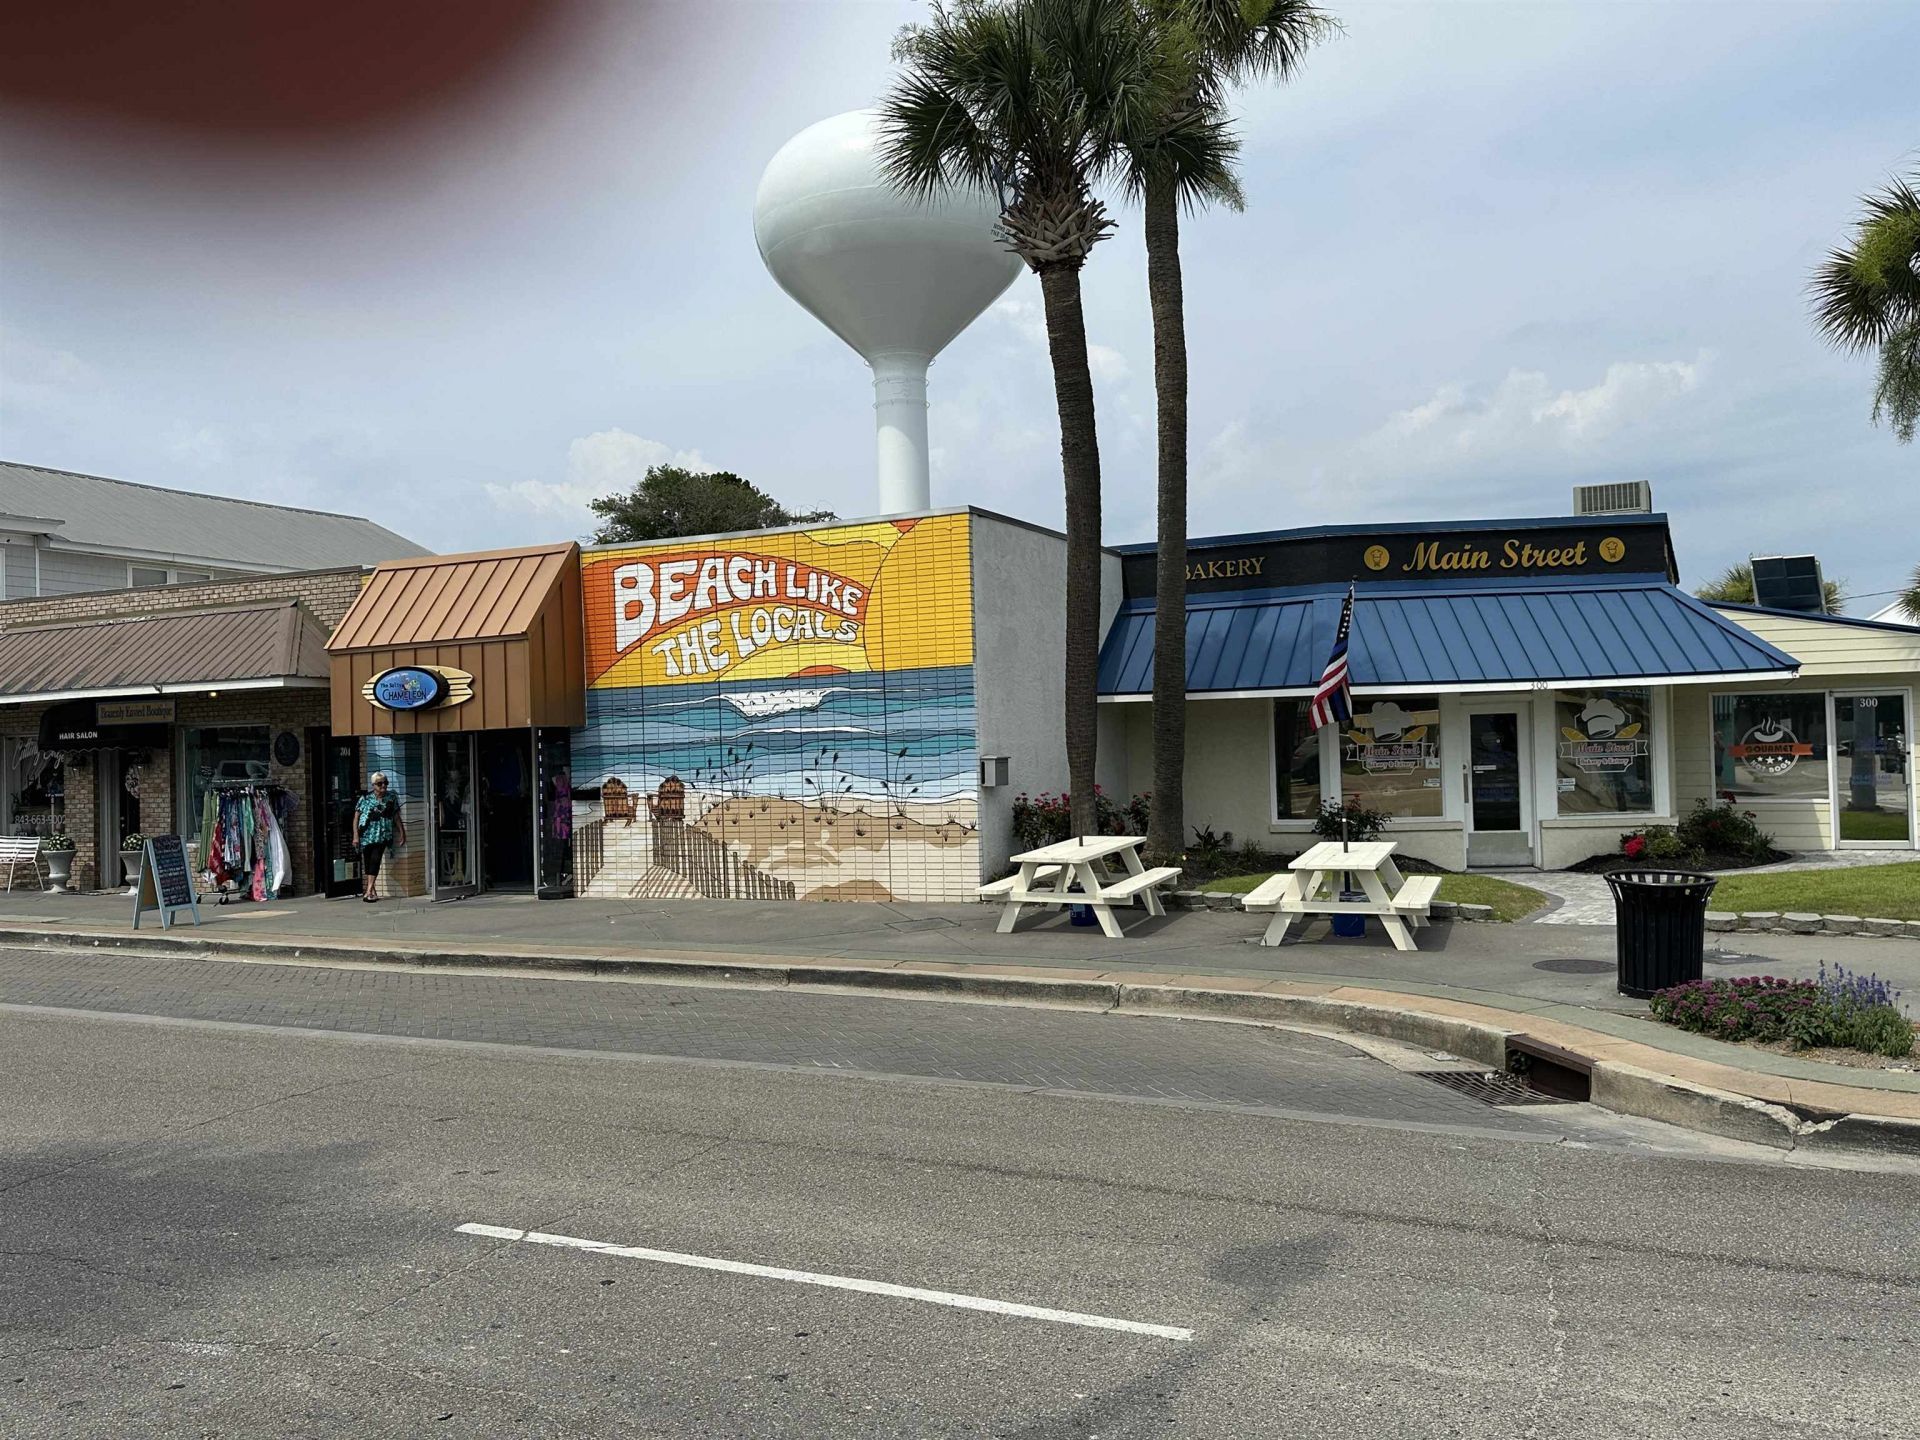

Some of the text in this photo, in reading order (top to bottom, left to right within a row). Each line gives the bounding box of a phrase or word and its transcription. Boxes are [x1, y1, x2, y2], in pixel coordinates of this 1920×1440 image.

[1403, 539, 1587, 571] Main Street
[613, 556, 864, 653] BEACH LIKE
[652, 606, 860, 677] THE LOCALS
[1531, 681, 1548, 690] 300
[382, 688, 427, 701] CHAMELEON
[1860, 698, 1878, 708] 300
[59, 731, 98, 740] HAIR SALON
[1578, 742, 1634, 753] Main Street
[1745, 745, 1793, 753] GOURMET
[1750, 760, 1791, 773] HOT DOGS
